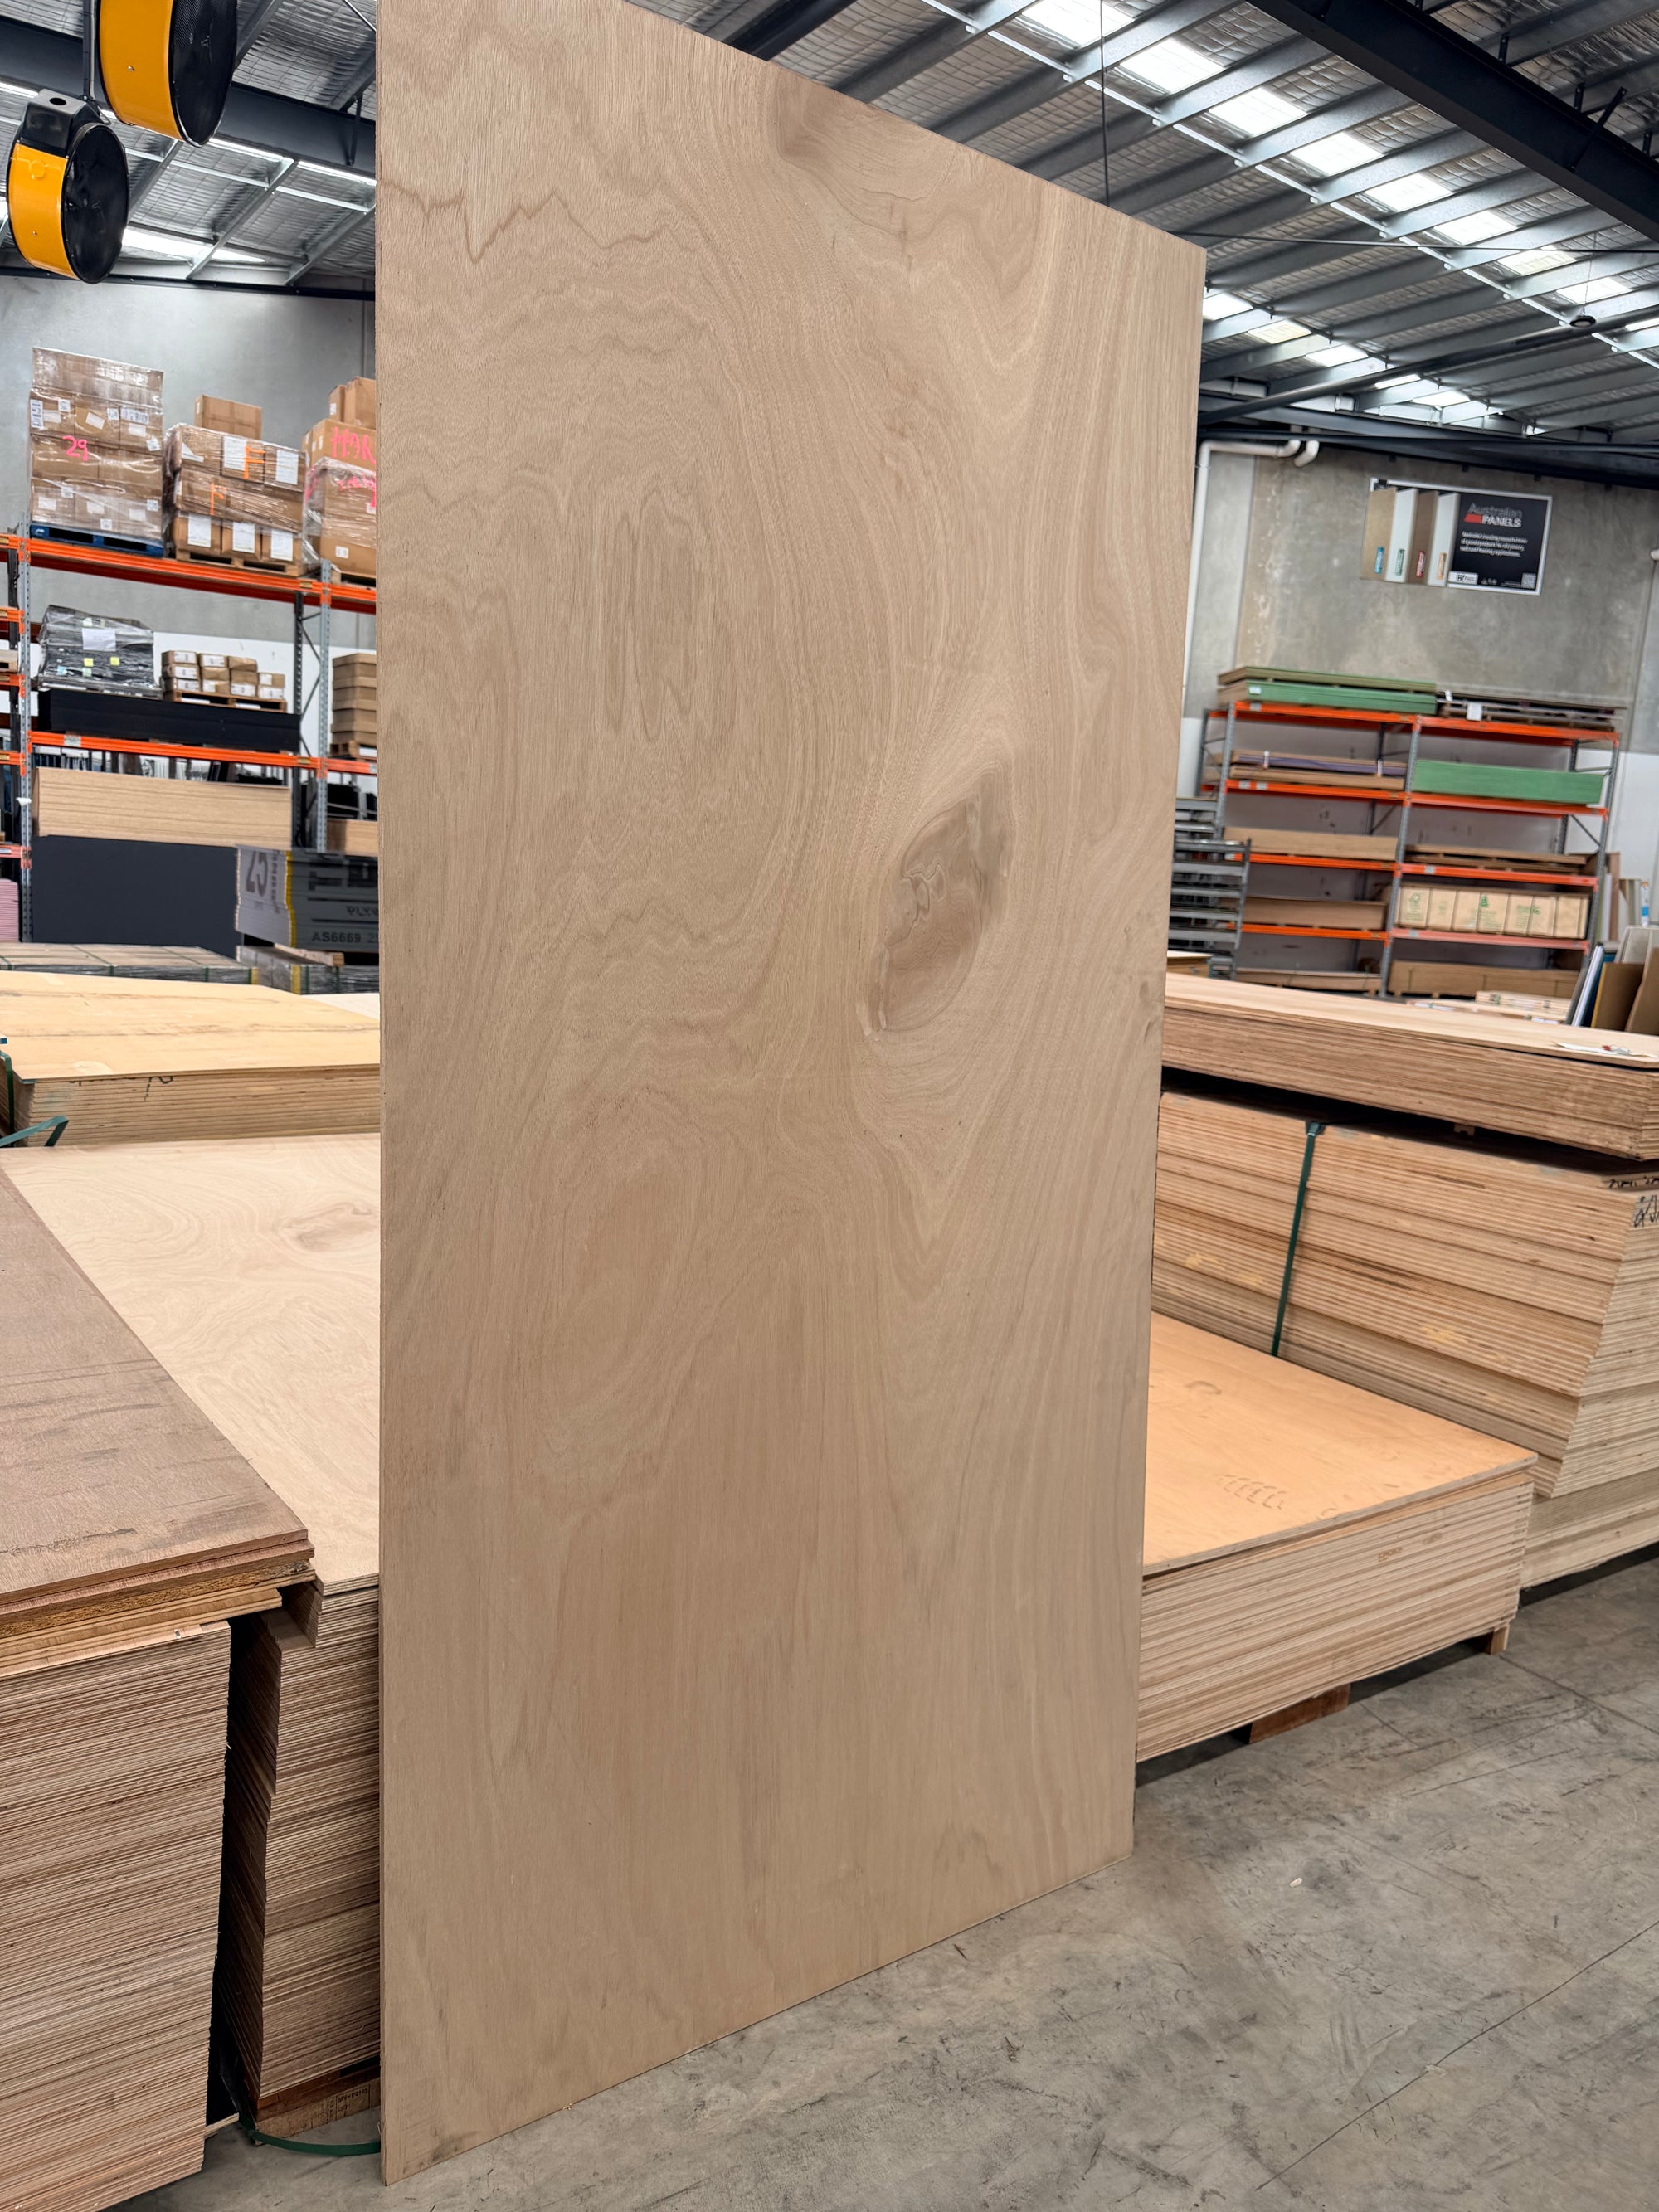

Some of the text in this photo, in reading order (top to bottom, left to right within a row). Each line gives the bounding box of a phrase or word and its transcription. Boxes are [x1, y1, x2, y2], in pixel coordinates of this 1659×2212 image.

[62, 435, 89, 461] 29
[243, 445, 265, 479] F
[1467, 502, 1523, 518] Australian
[1481, 514, 1522, 528] PANELS
